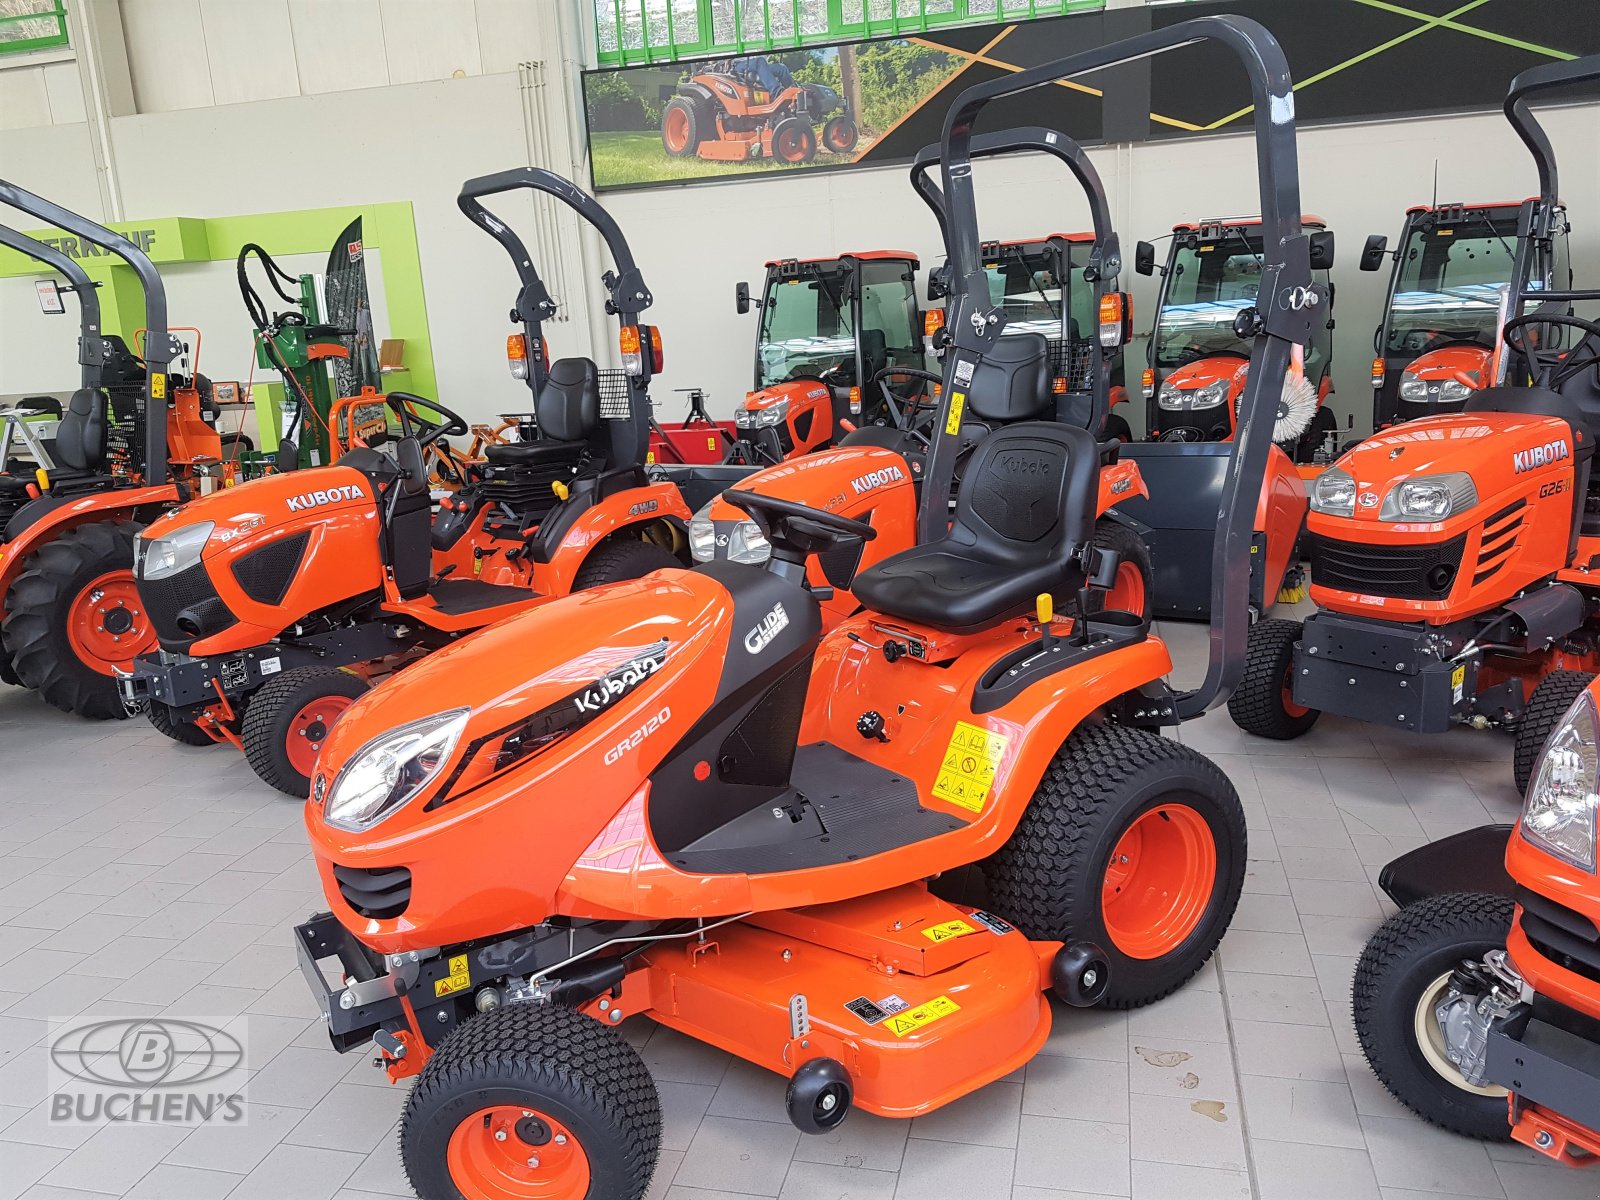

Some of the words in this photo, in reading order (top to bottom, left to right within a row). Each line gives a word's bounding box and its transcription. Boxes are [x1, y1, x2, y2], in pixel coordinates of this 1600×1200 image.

[1002, 456, 1049, 475] Kubota
[1513, 439, 1569, 475] KUBOTA
[850, 465, 904, 495] KUBOTA
[286, 485, 365, 512] KUBOTA
[628, 499, 659, 516] 4WD
[744, 601, 784, 655] GLIDE
[762, 615, 789, 646] STEER
[574, 656, 660, 713] Kubota
[603, 706, 672, 766] GR2120
